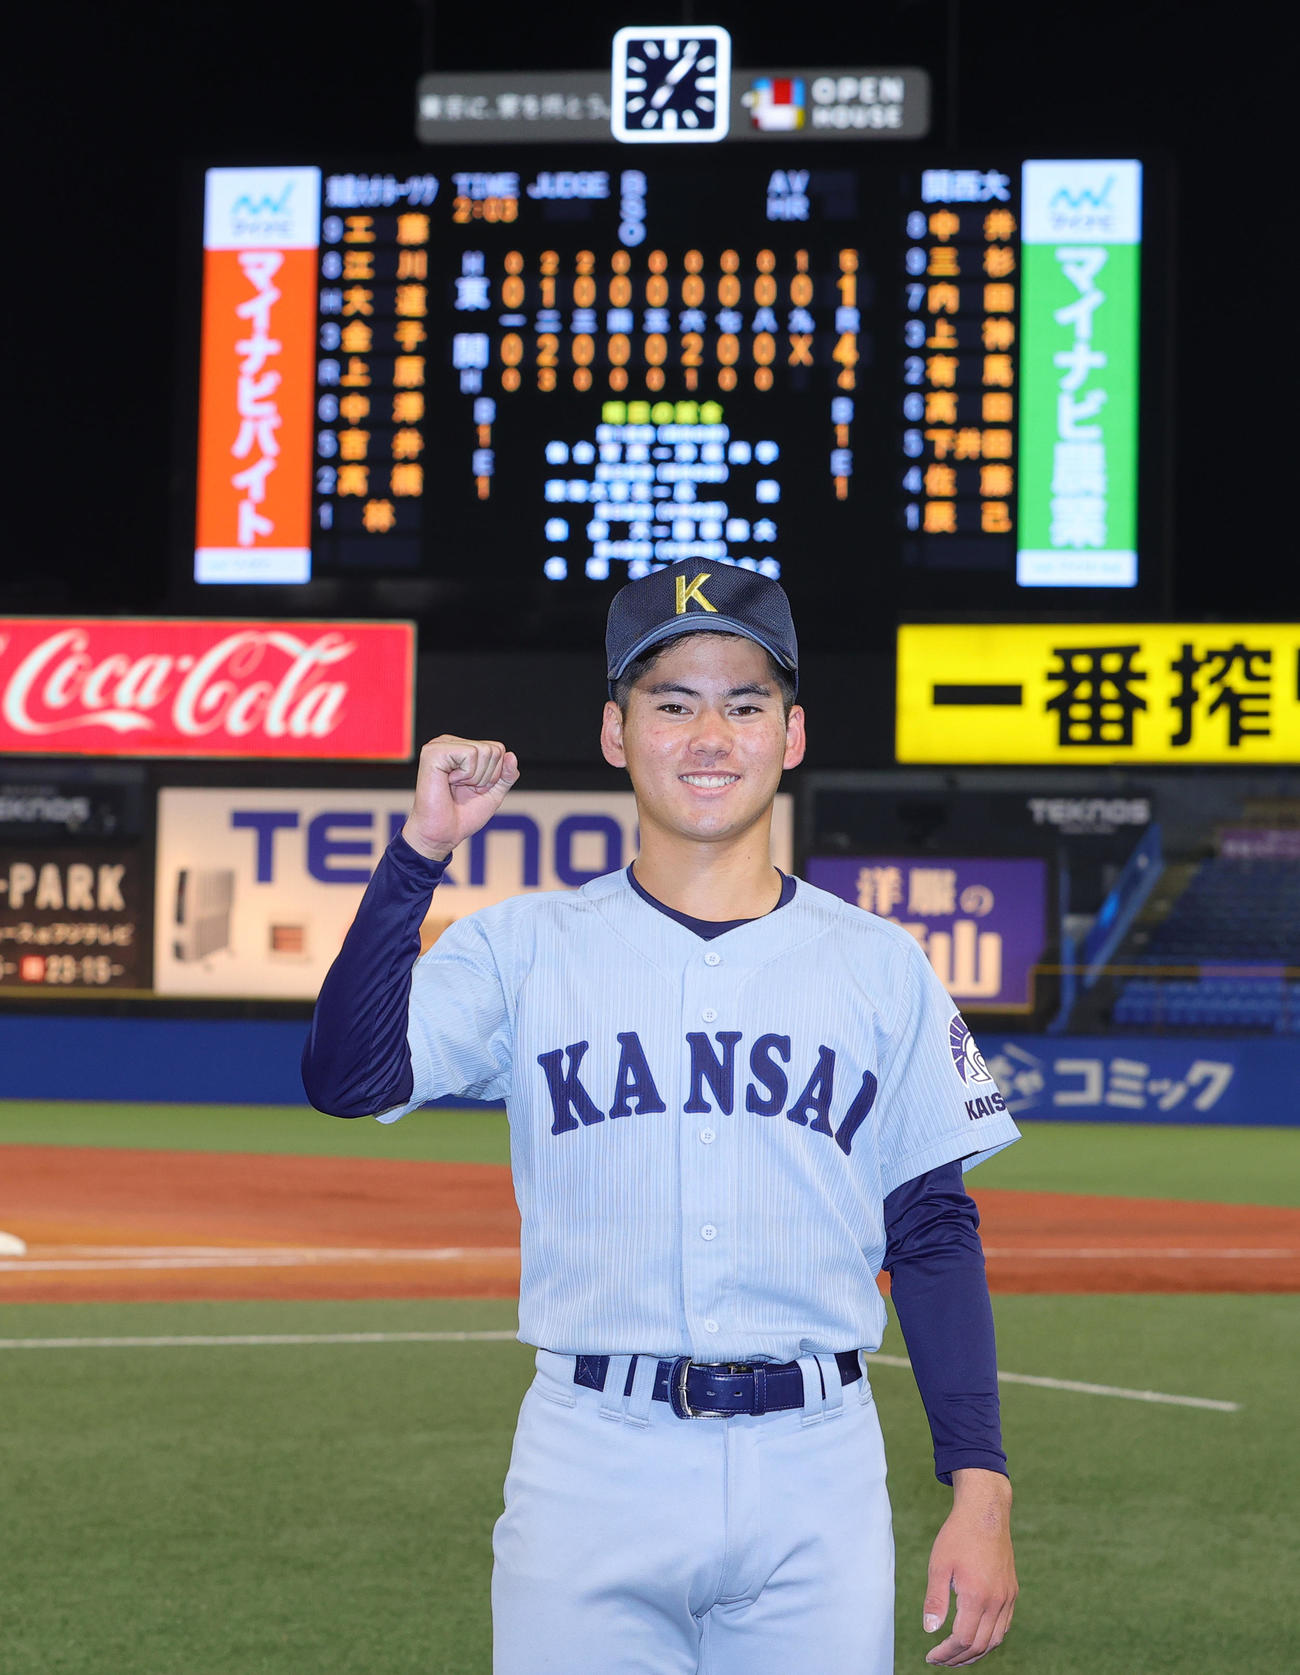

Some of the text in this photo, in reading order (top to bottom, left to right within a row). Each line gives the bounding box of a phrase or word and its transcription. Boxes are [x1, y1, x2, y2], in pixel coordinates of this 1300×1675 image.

[812, 78, 903, 104] OPEN
[813, 104, 900, 128] HOUSE
[452, 172, 520, 199] TIME
[527, 171, 610, 199] JUDGE
[502, 274, 524, 308] 0
[541, 274, 555, 307] 1
[574, 274, 595, 307] 0
[610, 274, 631, 307] 0
[646, 274, 668, 307] 0
[682, 274, 704, 307] 0
[718, 274, 740, 306] 0
[754, 274, 776, 308] 0
[791, 274, 812, 308] 0
[838, 274, 856, 308] 1
[501, 334, 522, 366] 0
[537, 331, 558, 367] 2
[572, 331, 595, 366] 0
[608, 331, 631, 366] 0
[645, 331, 667, 366] 0
[682, 331, 703, 366] 2
[717, 331, 739, 365] 0
[753, 331, 775, 365] 0
[789, 331, 812, 364] X
[833, 331, 859, 367] 4
[231, 250, 284, 547] マイナビバイト
[675, 572, 719, 615] K
[932, 643, 1300, 749] 一番搾
[537, 1031, 878, 1156] KANSAI
